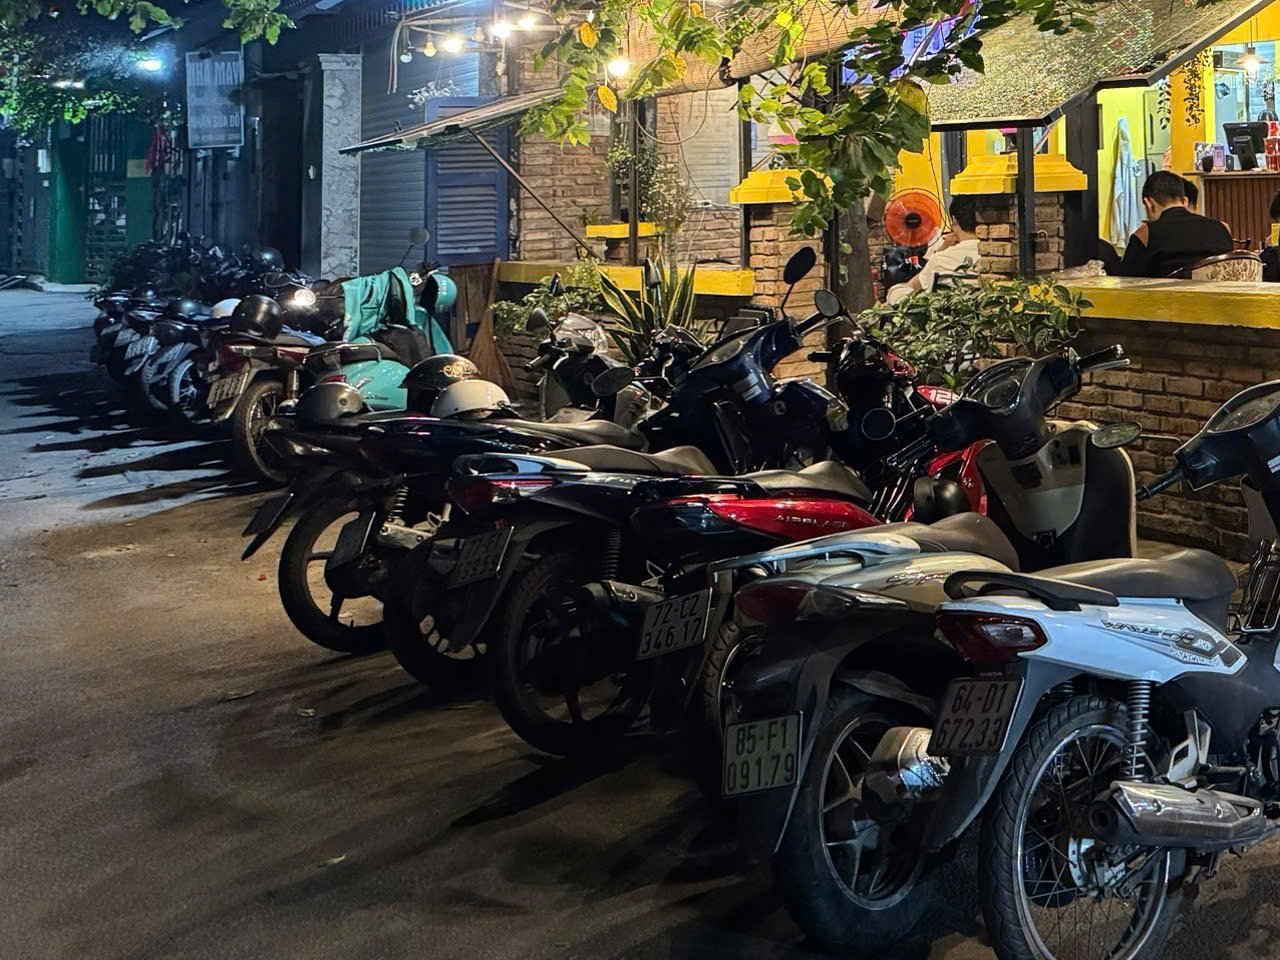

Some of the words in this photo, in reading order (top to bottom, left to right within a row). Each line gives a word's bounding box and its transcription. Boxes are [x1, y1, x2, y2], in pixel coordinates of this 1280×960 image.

[652, 594, 700, 627] 72-C2
[951, 683, 1009, 714] 64-D1
[735, 718, 788, 756] 85-F1
[727, 752, 795, 792] 091.79
